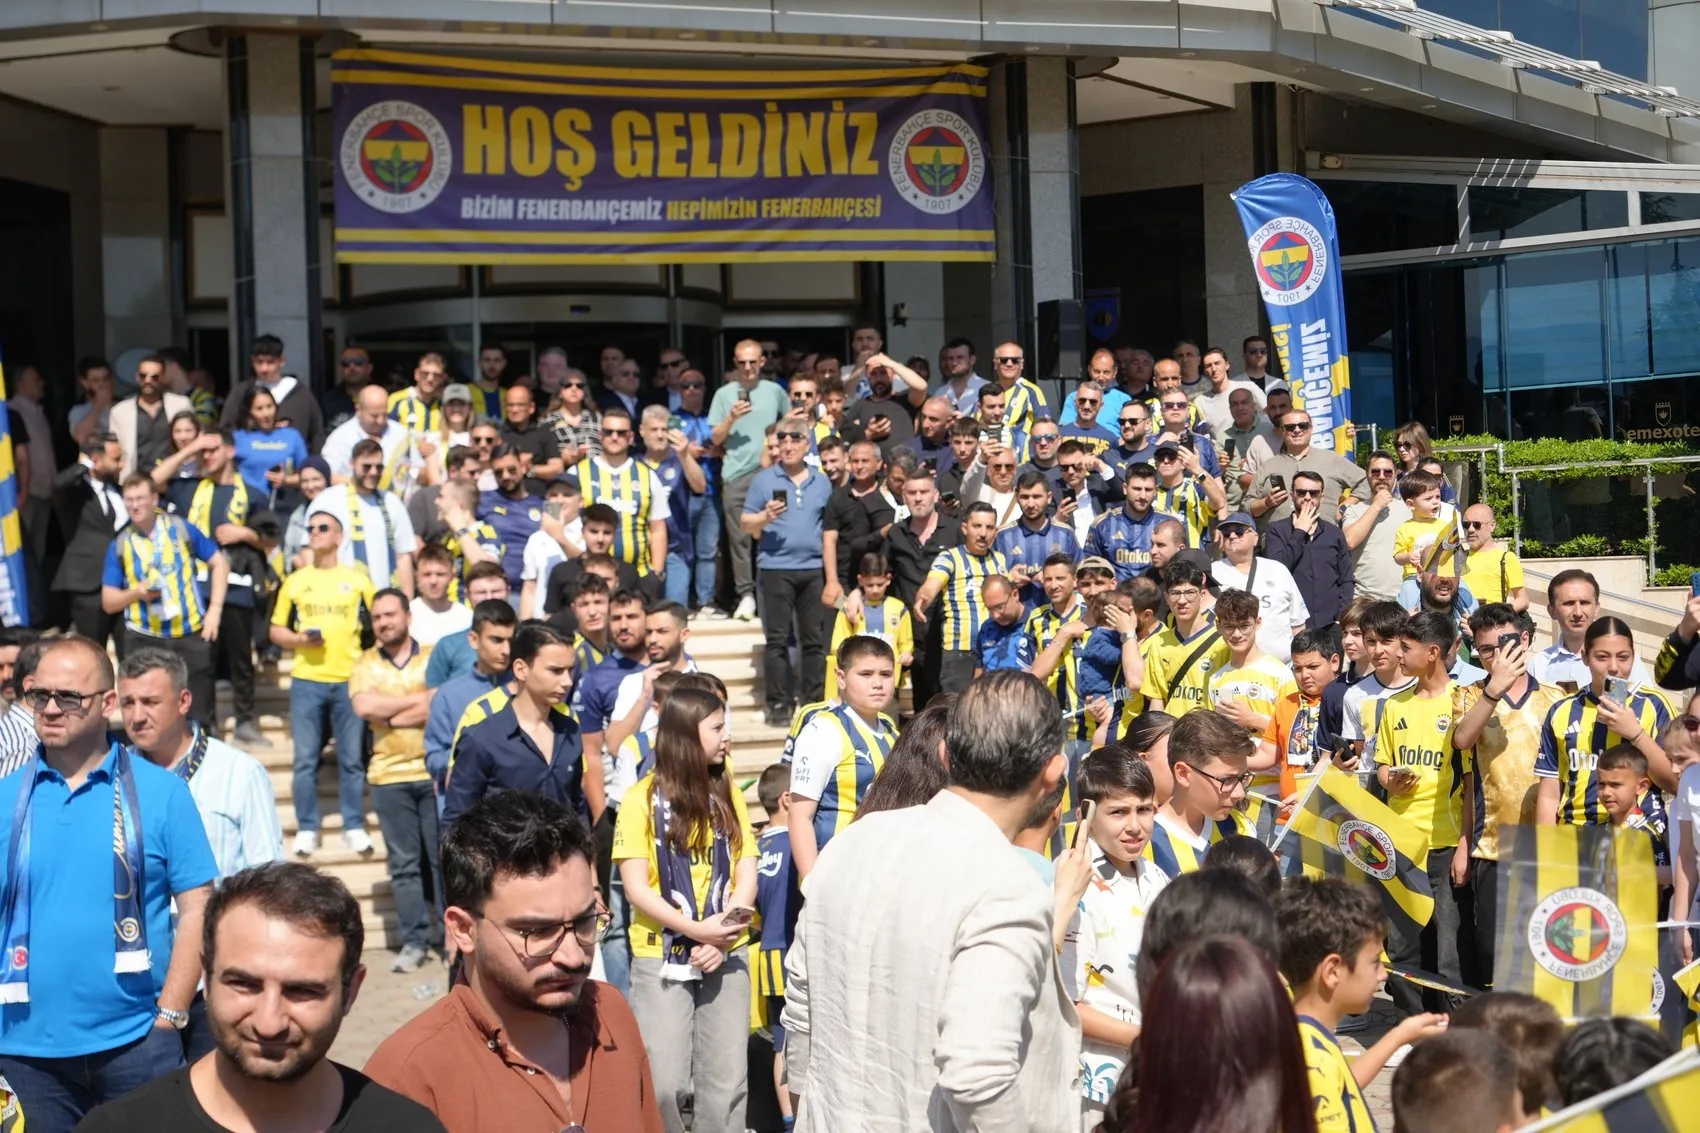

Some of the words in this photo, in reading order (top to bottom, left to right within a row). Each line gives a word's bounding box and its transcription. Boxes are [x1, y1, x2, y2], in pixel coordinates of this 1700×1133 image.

[463, 104, 596, 191] HOŞ
[611, 101, 878, 178] GELDİNİZ
[891, 112, 932, 193] FENERBAHÇE
[936, 112, 969, 138] SPOR
[461, 194, 513, 220] BİZİM
[517, 197, 662, 224] FENERBAHÇEMİZ
[666, 197, 757, 220] HEPİMİZİN
[761, 195, 881, 221] FENERBAHÇESİ
[925, 198, 952, 210] 1907
[1115, 548, 1152, 564] Otoko
[1568, 748, 1603, 772] Oto
[1340, 822, 1374, 845] FENERBAHÇE
[1375, 831, 1393, 856] SPOR
